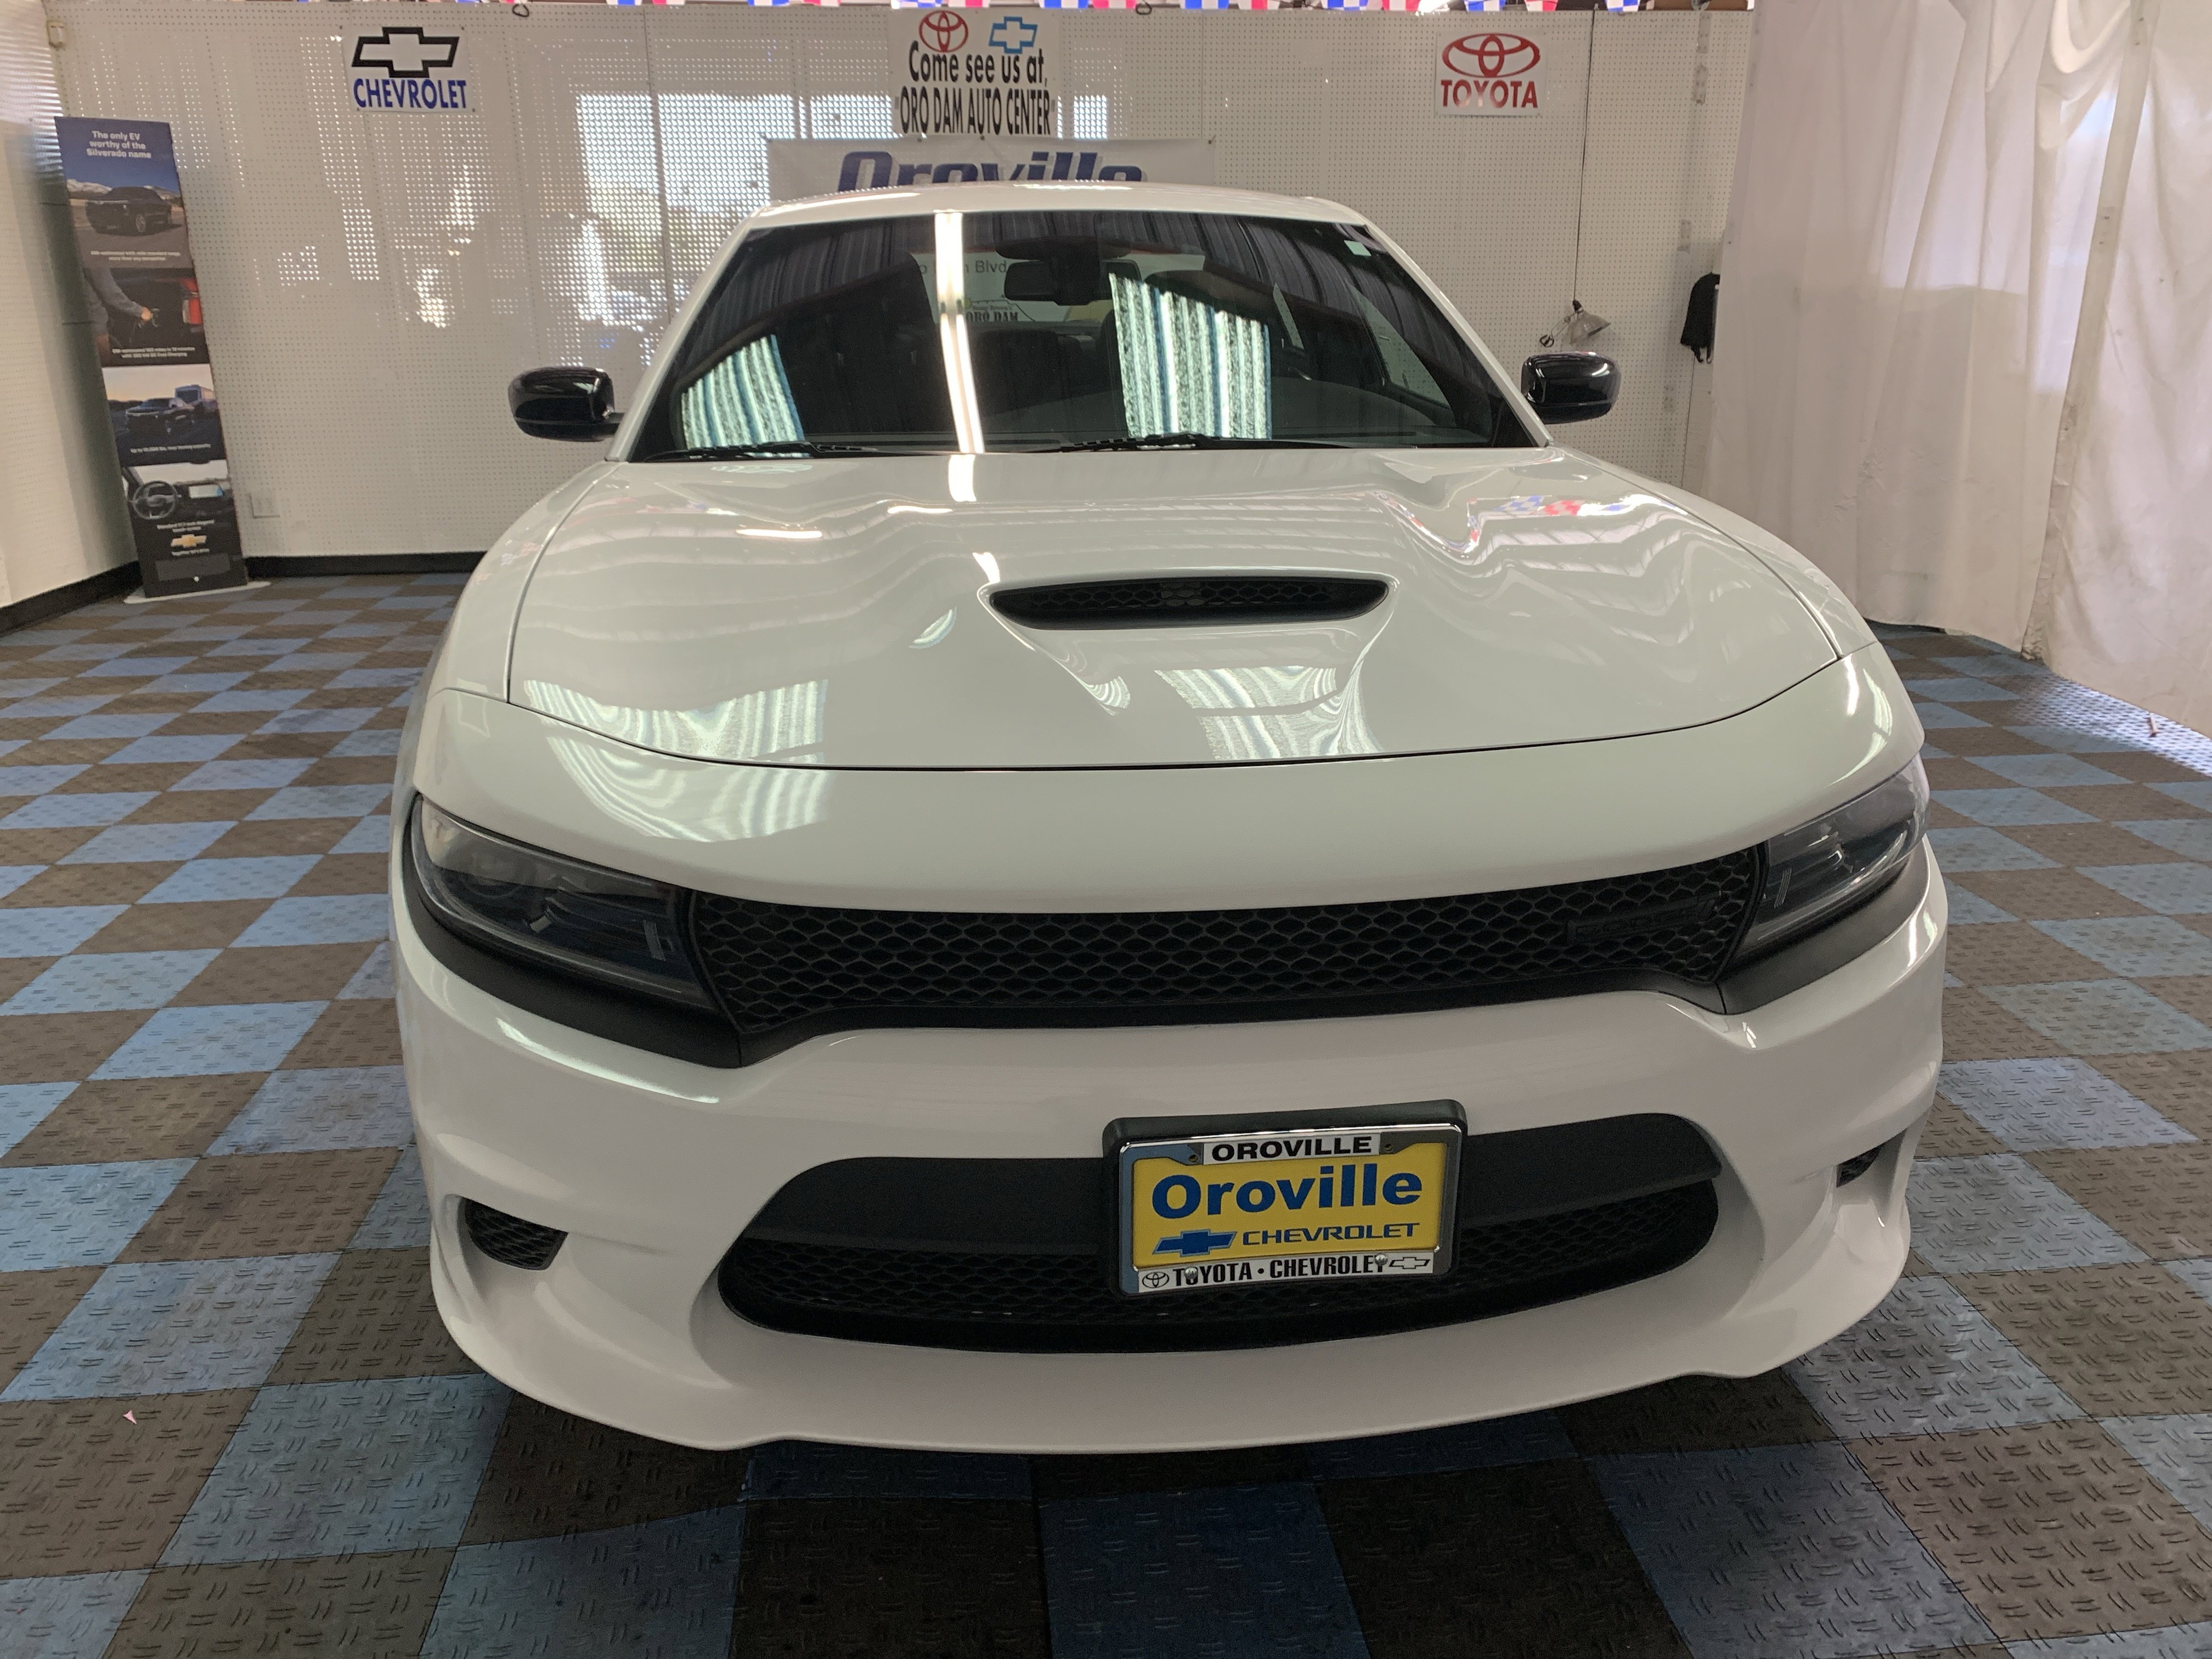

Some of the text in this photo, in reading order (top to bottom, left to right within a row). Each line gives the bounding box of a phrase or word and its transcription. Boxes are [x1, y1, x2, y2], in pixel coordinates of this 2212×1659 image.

[909, 41, 959, 82] Come
[966, 54, 995, 83] see
[1001, 55, 1020, 83] us
[354, 78, 466, 109] CHEVROLET
[1441, 80, 1538, 108] TOYOTA
[933, 87, 963, 133] DAM
[967, 88, 1002, 135] AUTO
[89, 140, 120, 149] worthy
[92, 131, 140, 141] The only EV
[86, 148, 127, 157] Silverado
[975, 259, 1007, 273] Blvd
[994, 311, 1019, 322] DAM
[1212, 1136, 1372, 1161] OROVILLE
[1152, 1163, 1423, 1219] Oroville
[1242, 1222, 1420, 1245] CHEVROLET
[1172, 1262, 1252, 1286] TOYOTA
